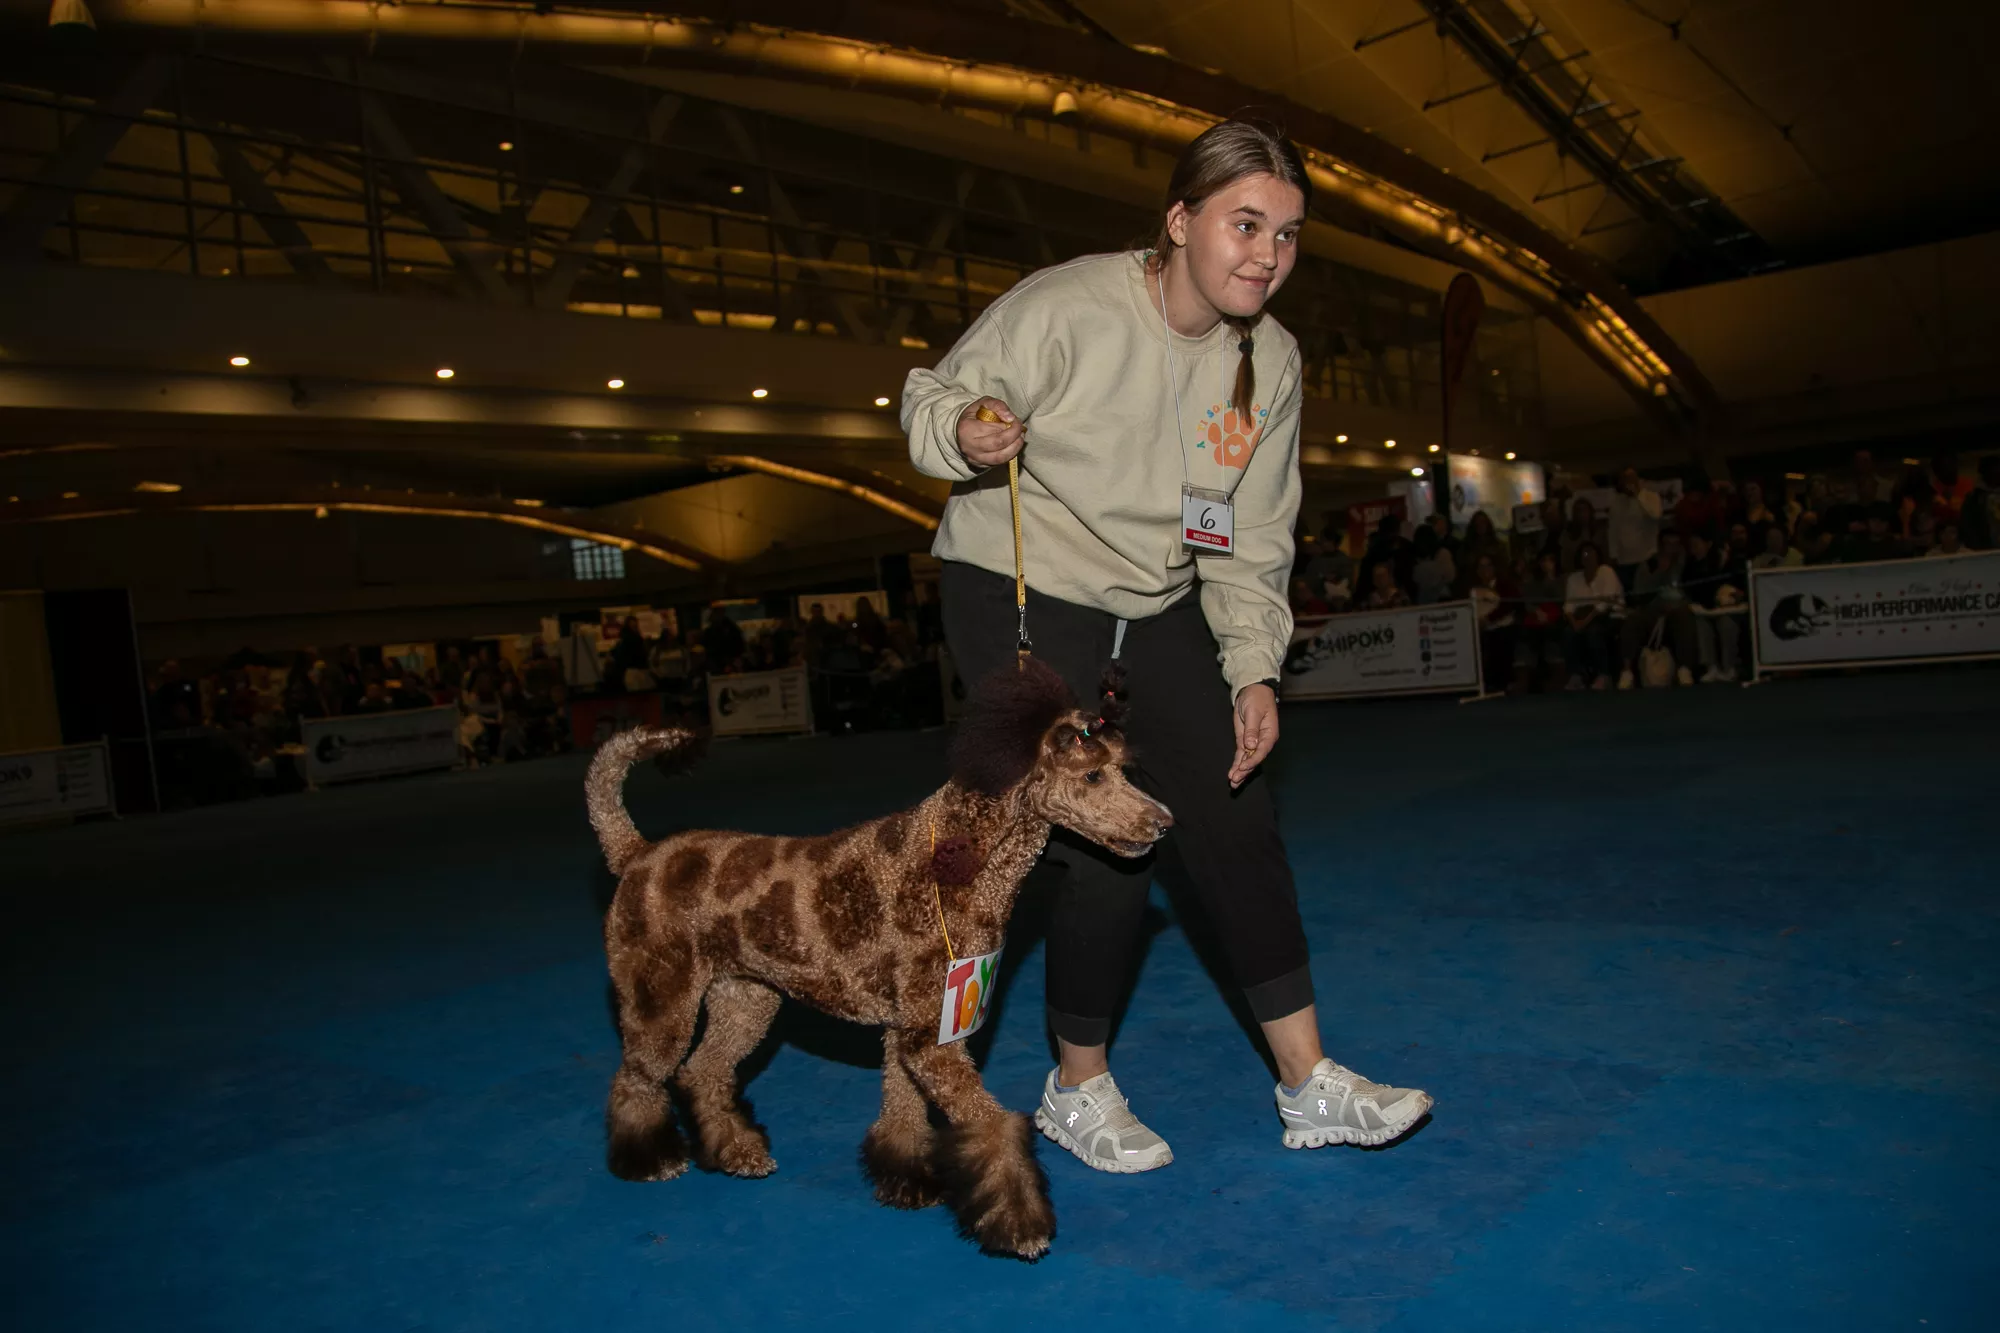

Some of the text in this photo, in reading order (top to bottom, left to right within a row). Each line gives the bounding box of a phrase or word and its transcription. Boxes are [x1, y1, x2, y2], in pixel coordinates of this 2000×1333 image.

[1200, 507, 1216, 529] 6
[1193, 532, 1222, 544] MEDIUM DOG
[1836, 603, 1869, 620] HIGH
[1872, 595, 1981, 617] PERFORMANCE
